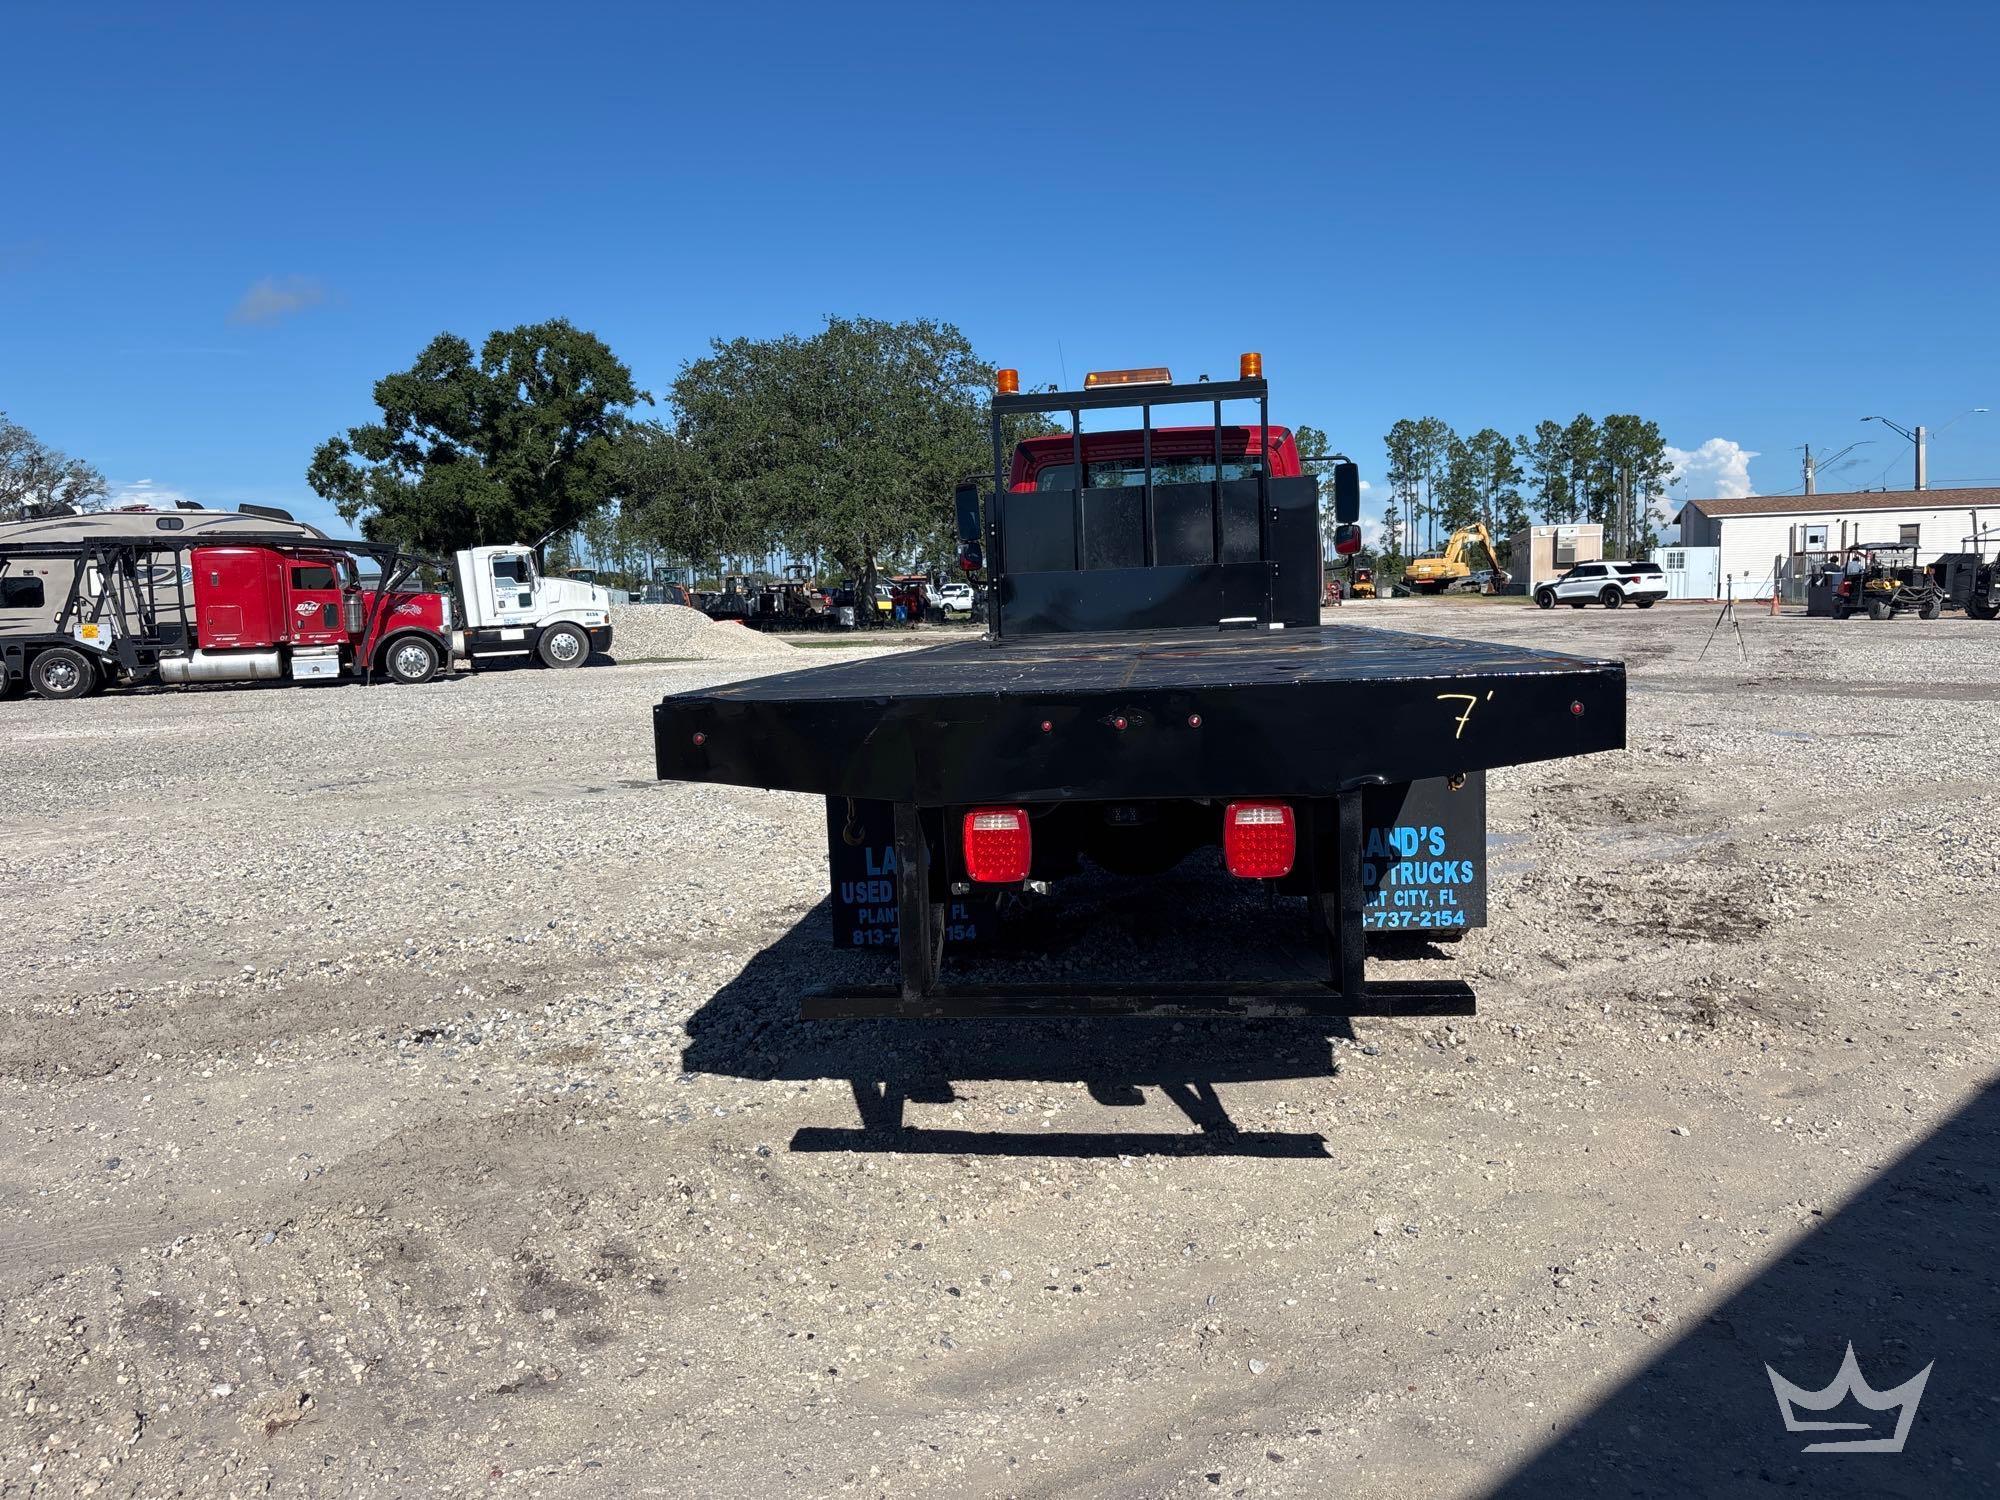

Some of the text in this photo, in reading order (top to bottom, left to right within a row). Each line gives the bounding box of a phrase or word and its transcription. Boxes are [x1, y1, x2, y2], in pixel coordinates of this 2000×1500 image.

[1437, 690, 1493, 739] 7'
[1363, 826, 1445, 857] AND'S
[1387, 860, 1473, 885] TRUCKS
[841, 880, 892, 904] USED
[1394, 889, 1433, 908] CITY,
[1440, 889, 1457, 905] FL
[952, 904, 968, 920] FL
